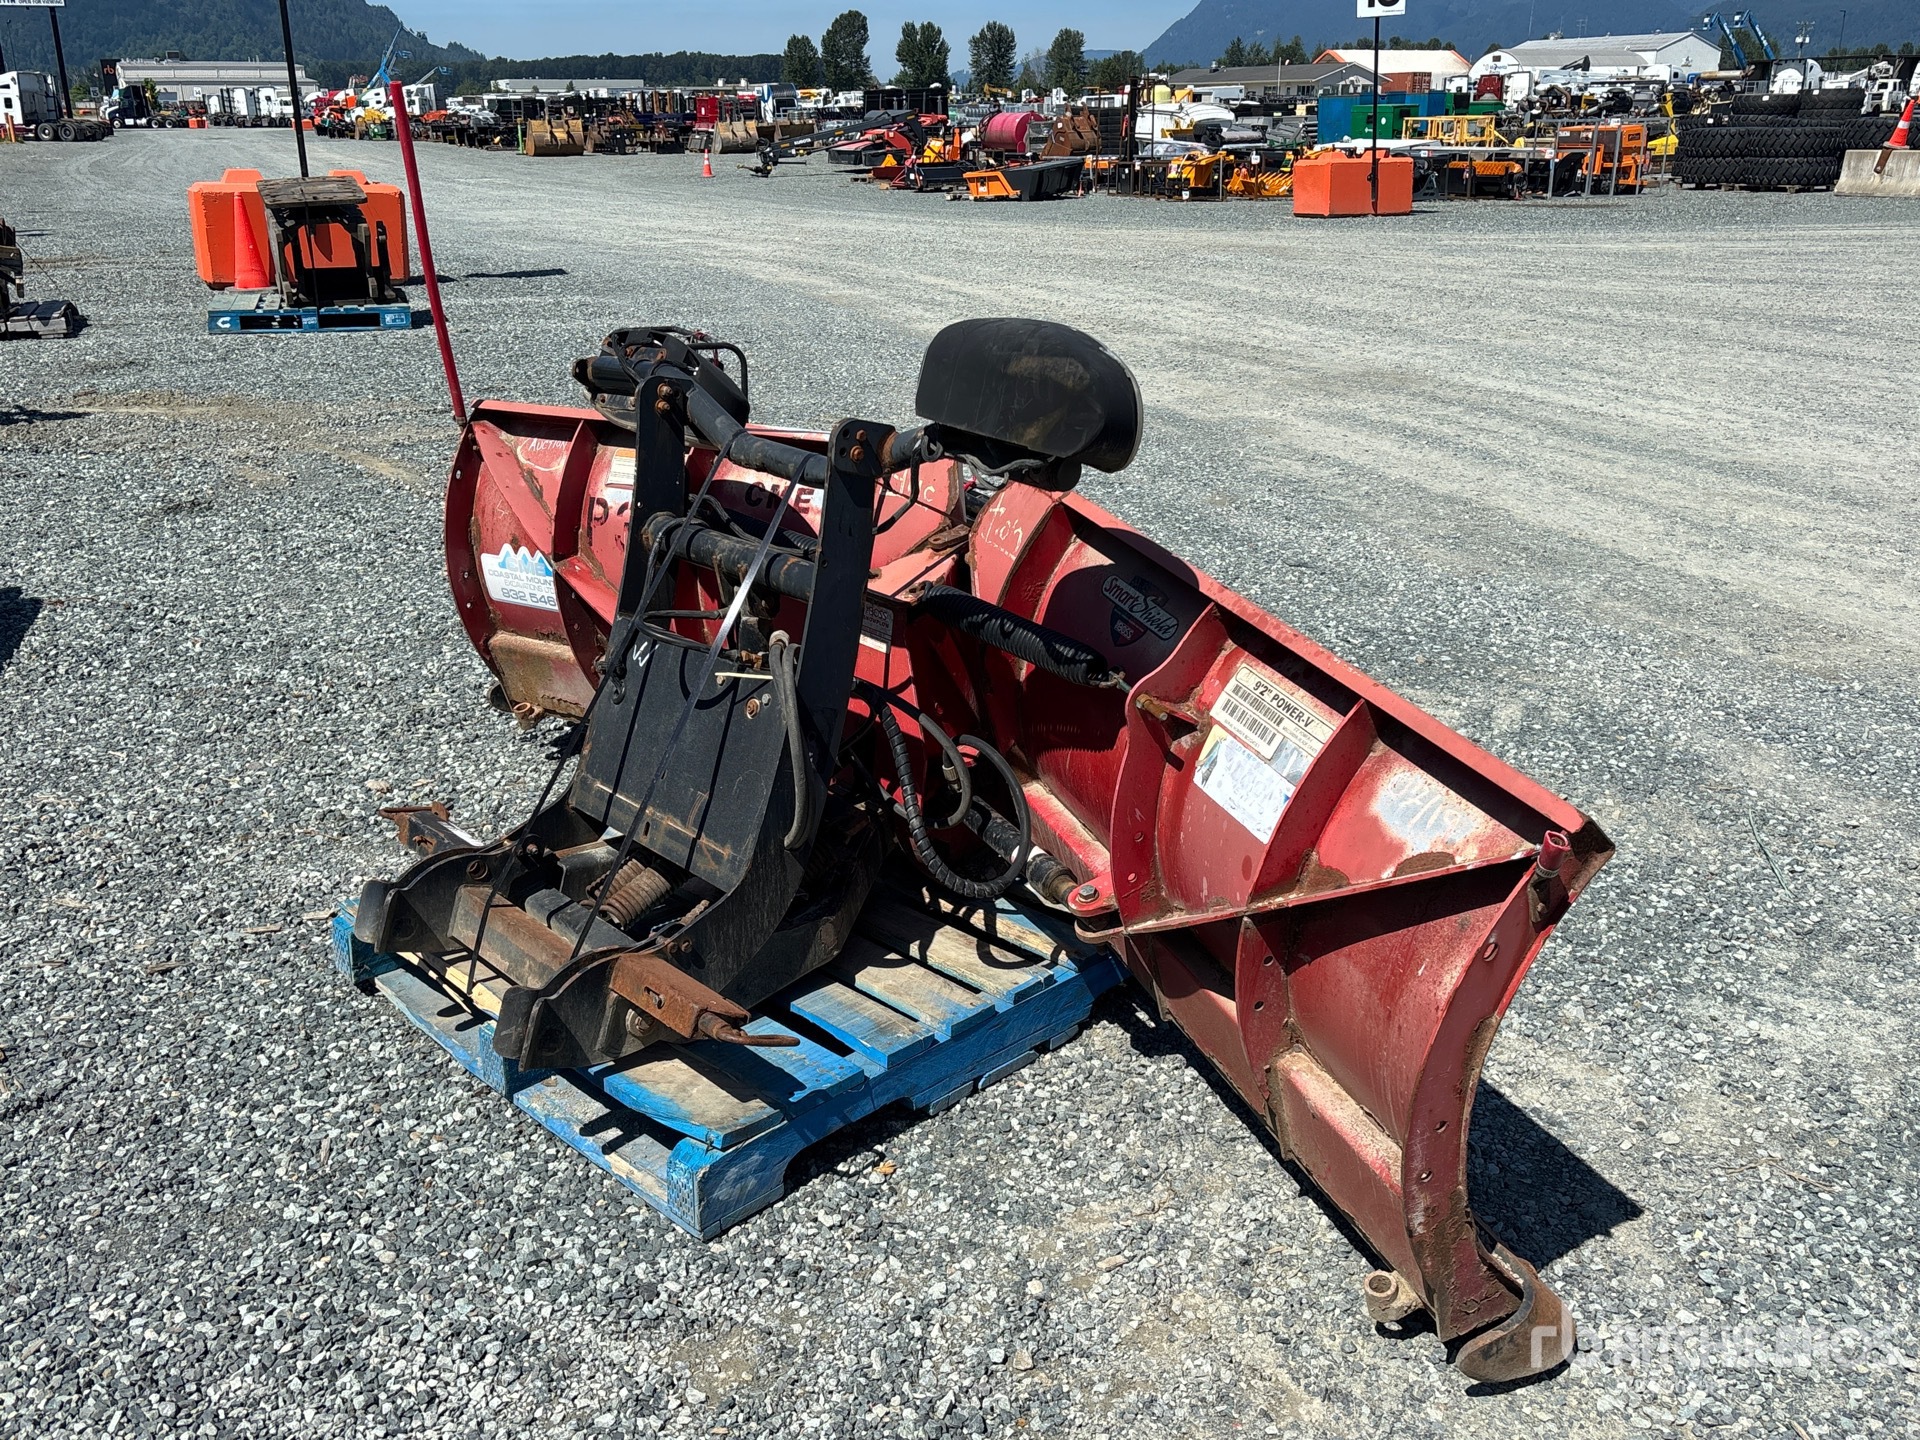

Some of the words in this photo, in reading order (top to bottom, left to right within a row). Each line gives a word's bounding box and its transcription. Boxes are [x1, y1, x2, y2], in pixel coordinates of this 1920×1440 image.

[528, 437, 567, 452] AUCTION
[487, 569, 525, 582] COASTAL
[506, 557, 547, 577] CME
[1252, 680, 1274, 697] 9'2"
[1270, 693, 1315, 728] POWER-V
